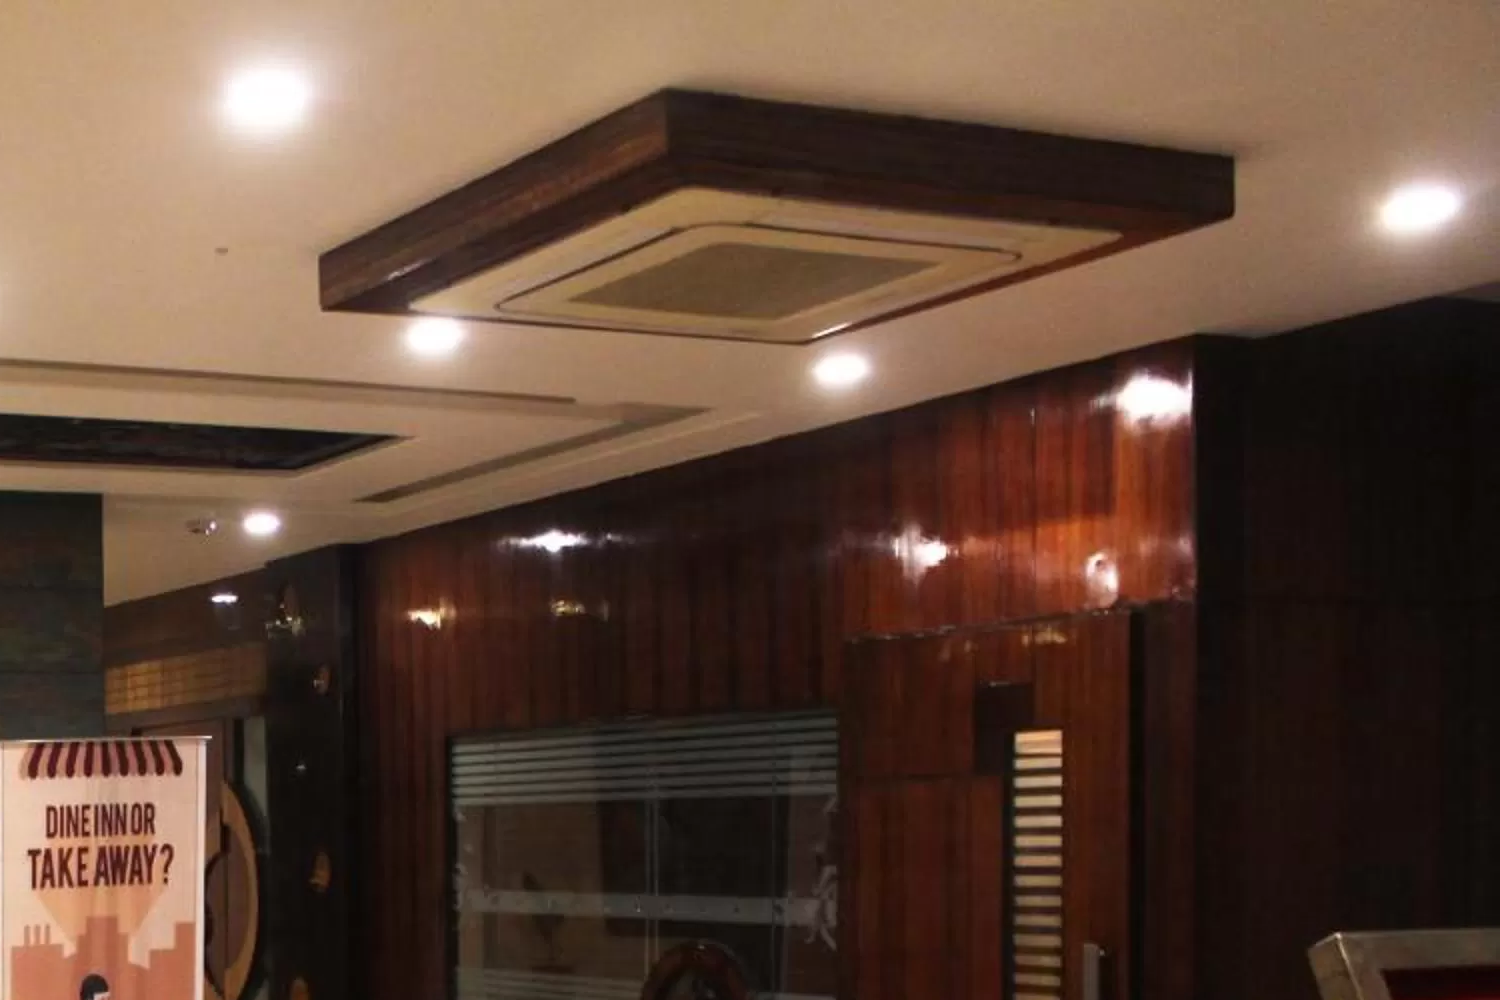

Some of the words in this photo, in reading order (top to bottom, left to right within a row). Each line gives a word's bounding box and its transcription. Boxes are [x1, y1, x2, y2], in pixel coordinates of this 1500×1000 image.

[46, 804, 91, 838] DINE
[94, 803, 127, 837] INN
[131, 802, 155, 835] OR
[27, 847, 89, 889] TAKE
[94, 843, 174, 887] AWAY?
